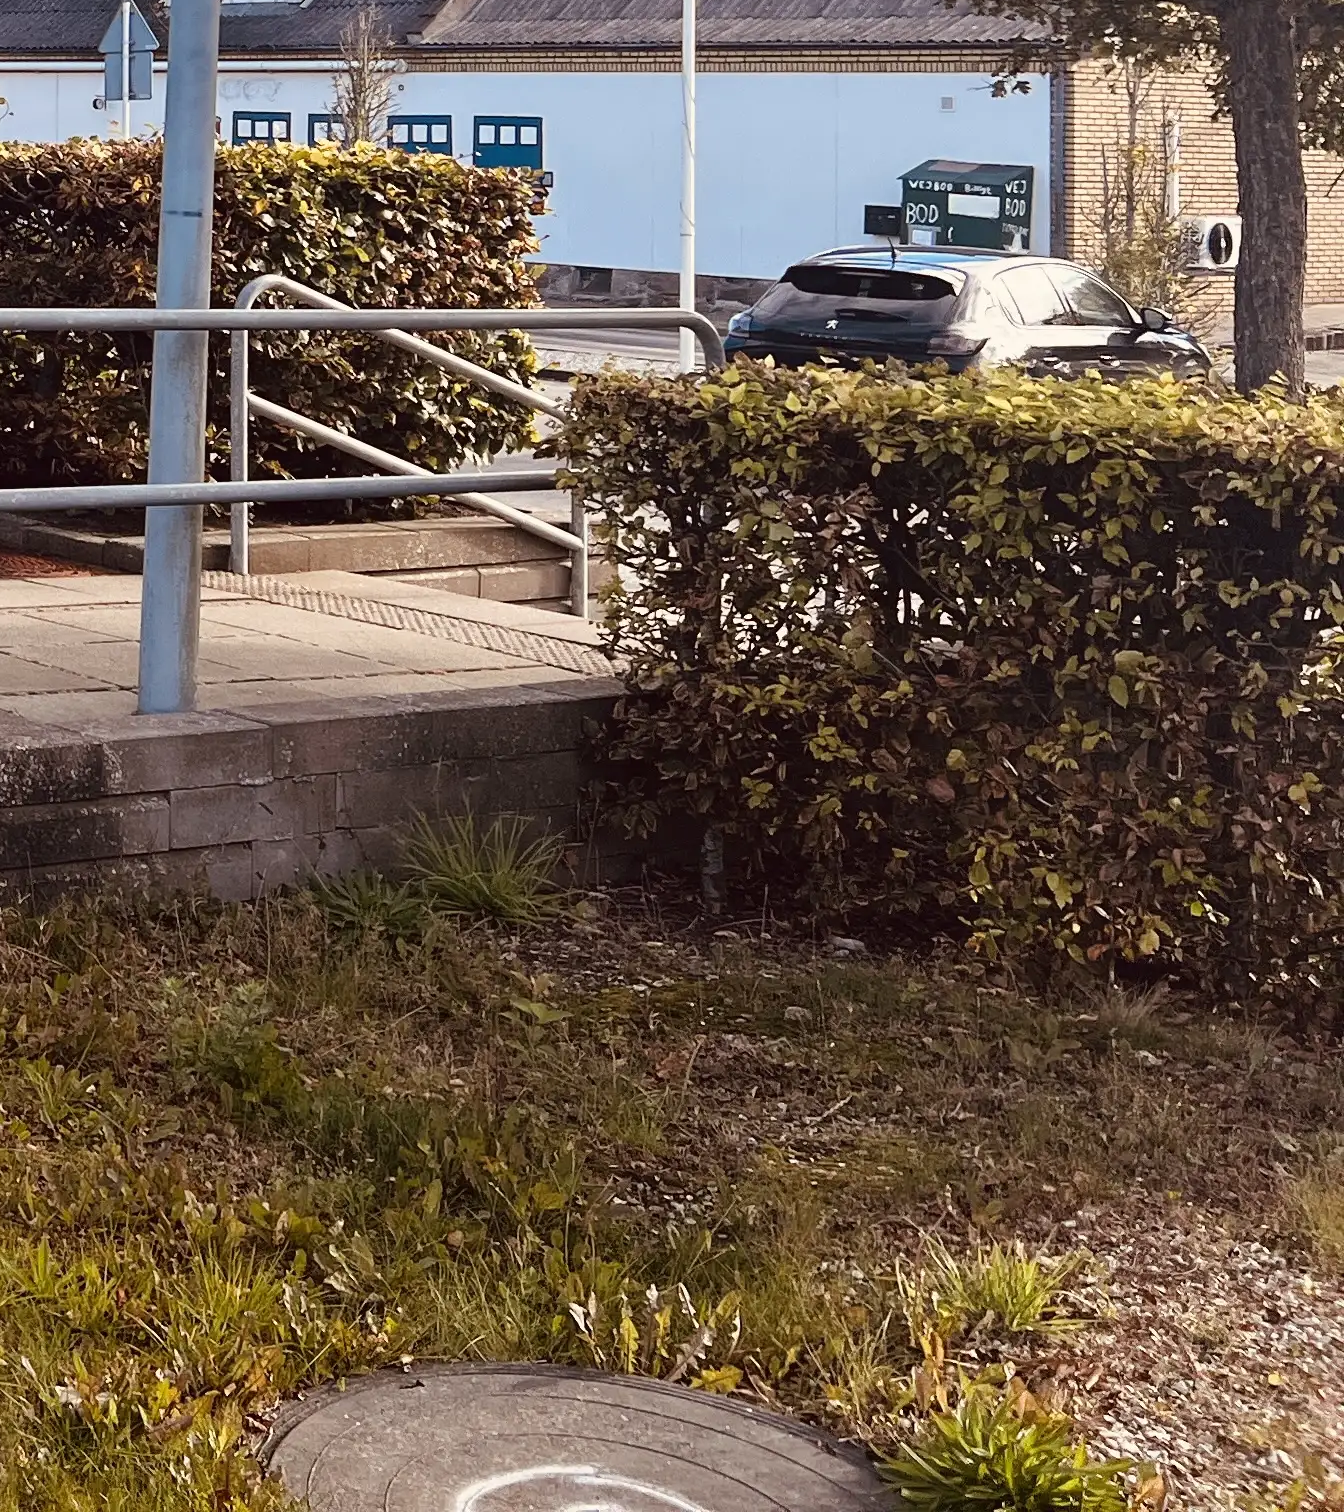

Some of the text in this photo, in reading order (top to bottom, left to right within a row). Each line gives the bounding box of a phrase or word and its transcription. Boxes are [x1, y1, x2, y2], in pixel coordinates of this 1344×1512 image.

[1004, 179, 1027, 194] VEJ
[905, 202, 939, 224] BOD
[1005, 197, 1026, 217] BOD
